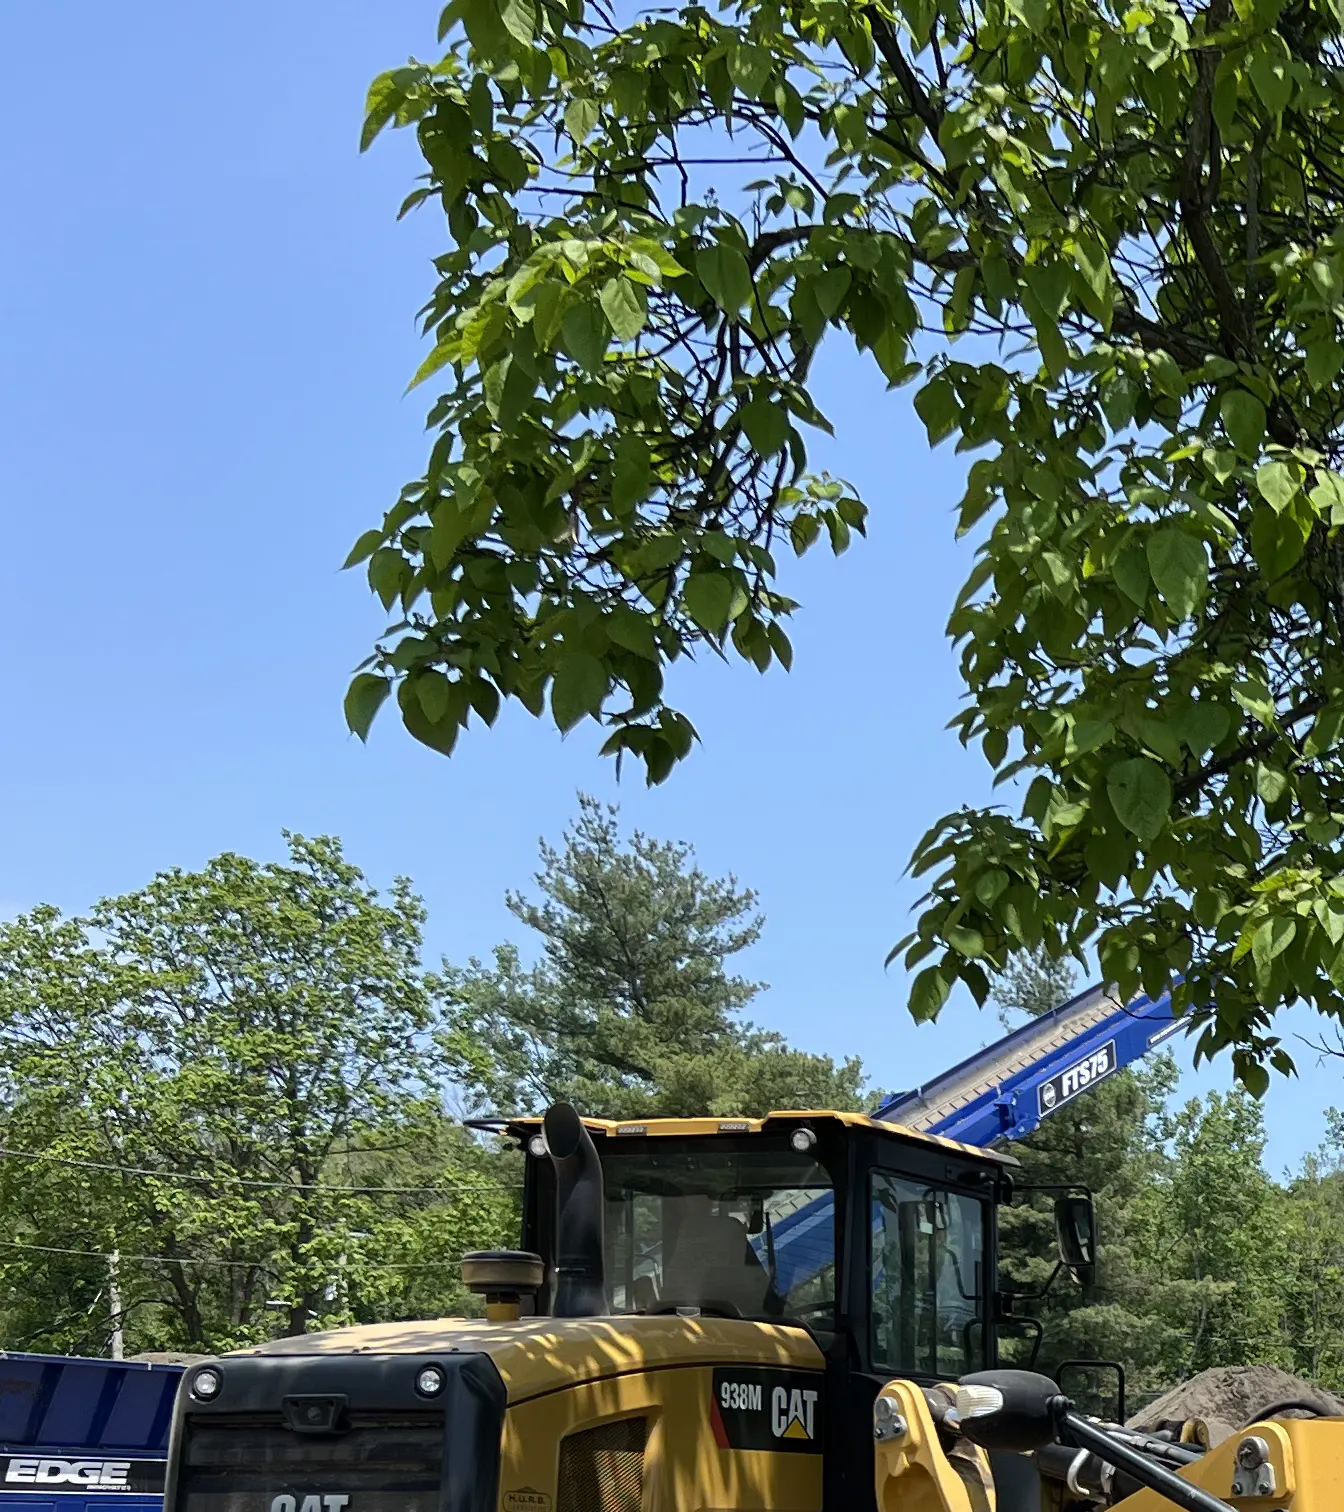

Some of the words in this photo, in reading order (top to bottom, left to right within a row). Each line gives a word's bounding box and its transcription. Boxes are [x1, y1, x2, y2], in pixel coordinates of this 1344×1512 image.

[1061, 1048, 1109, 1097] FTS75
[721, 1382, 762, 1411] 938M
[772, 1386, 818, 1439] CAT
[5, 1458, 131, 1485] EDGE
